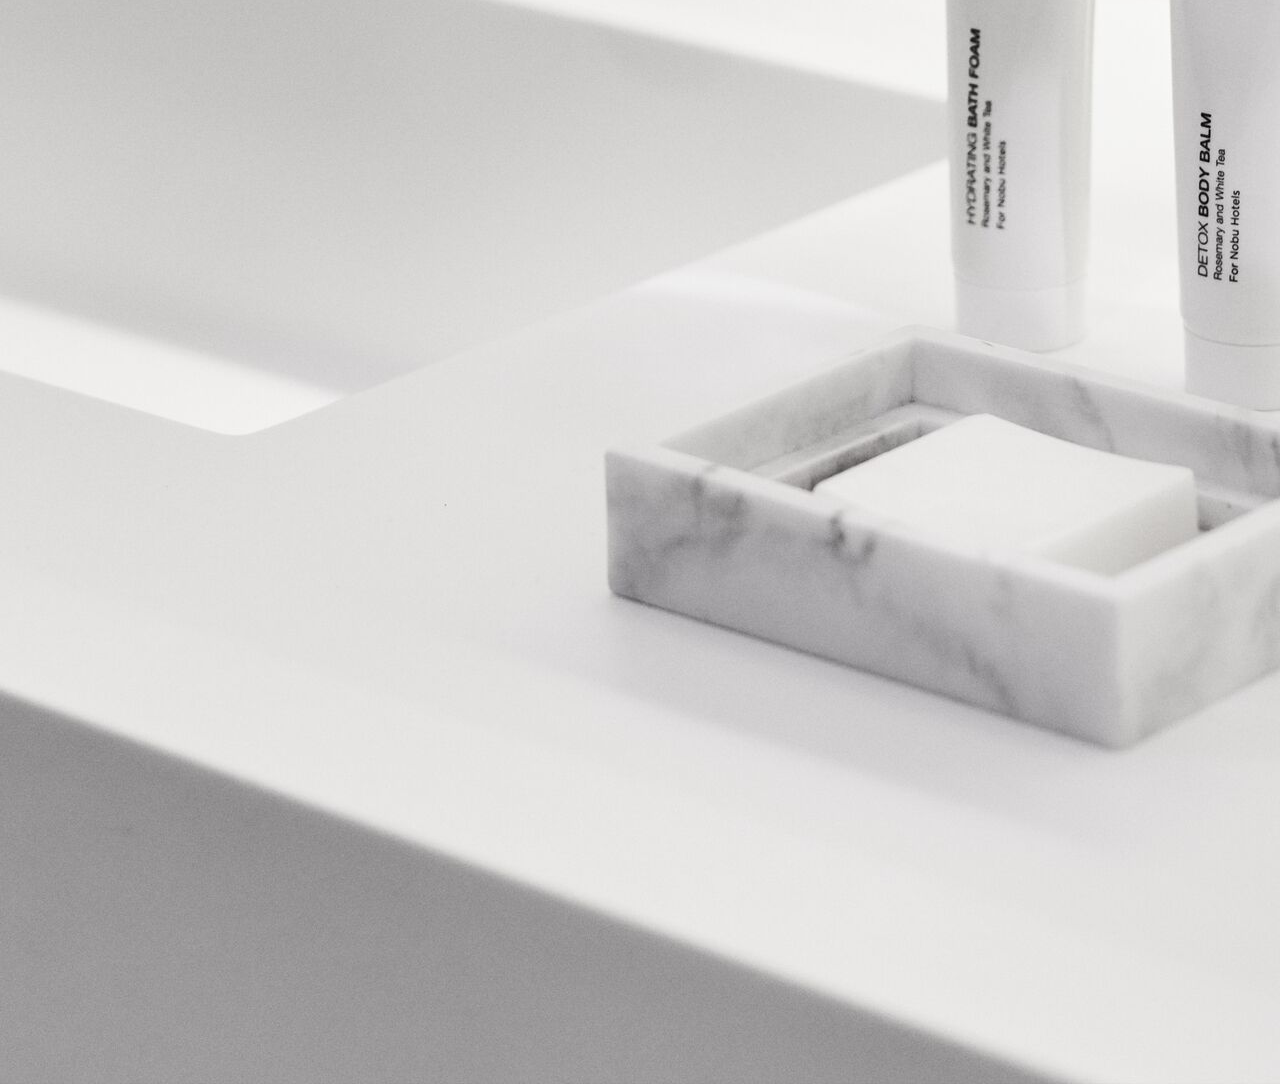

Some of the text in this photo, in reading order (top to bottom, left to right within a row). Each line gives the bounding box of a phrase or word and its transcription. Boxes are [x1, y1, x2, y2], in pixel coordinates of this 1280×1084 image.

[969, 28, 981, 79] FOAM
[967, 83, 978, 128] BATH
[983, 100, 992, 117] Tea
[997, 141, 1006, 230] For Nobu Hotels
[1198, 112, 1212, 278] DETOX BODY BALM
[1214, 149, 1225, 281] Rosemary and White Tea
[1229, 190, 1240, 282] For Nobu Hotels
